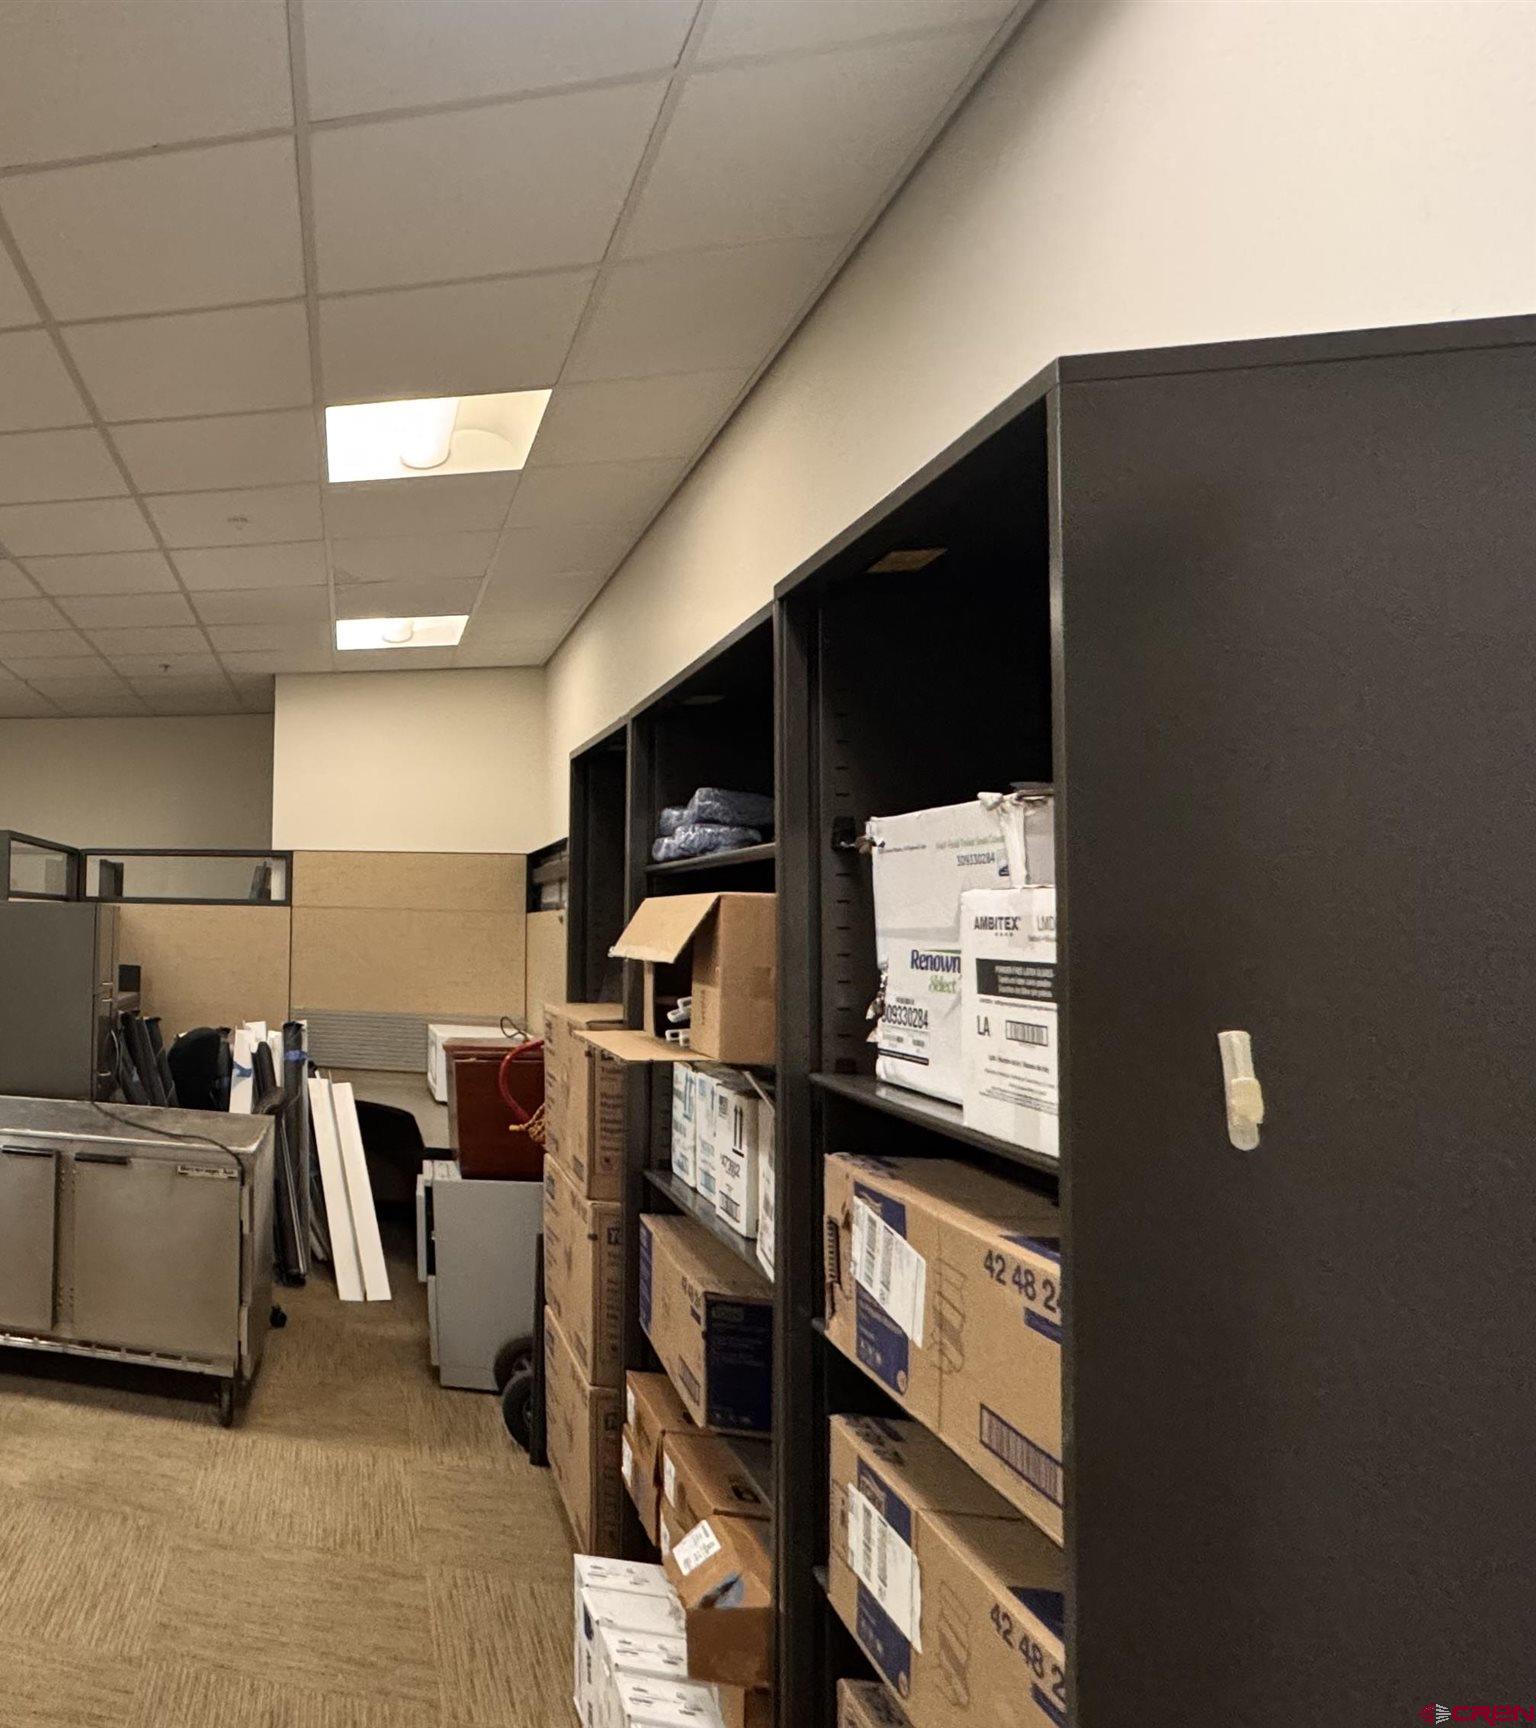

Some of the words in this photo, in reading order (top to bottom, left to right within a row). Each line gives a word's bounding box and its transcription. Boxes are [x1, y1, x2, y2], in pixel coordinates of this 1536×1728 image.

[974, 916, 1019, 931] AMBITEX
[911, 949, 961, 973] Renown
[976, 1014, 991, 1037] LA
[983, 1249, 1006, 1286] 42
[1012, 1265, 1036, 1301] 48
[1042, 1279, 1061, 1313] 2
[990, 1603, 1015, 1649] 42
[1018, 1632, 1045, 1679] 48
